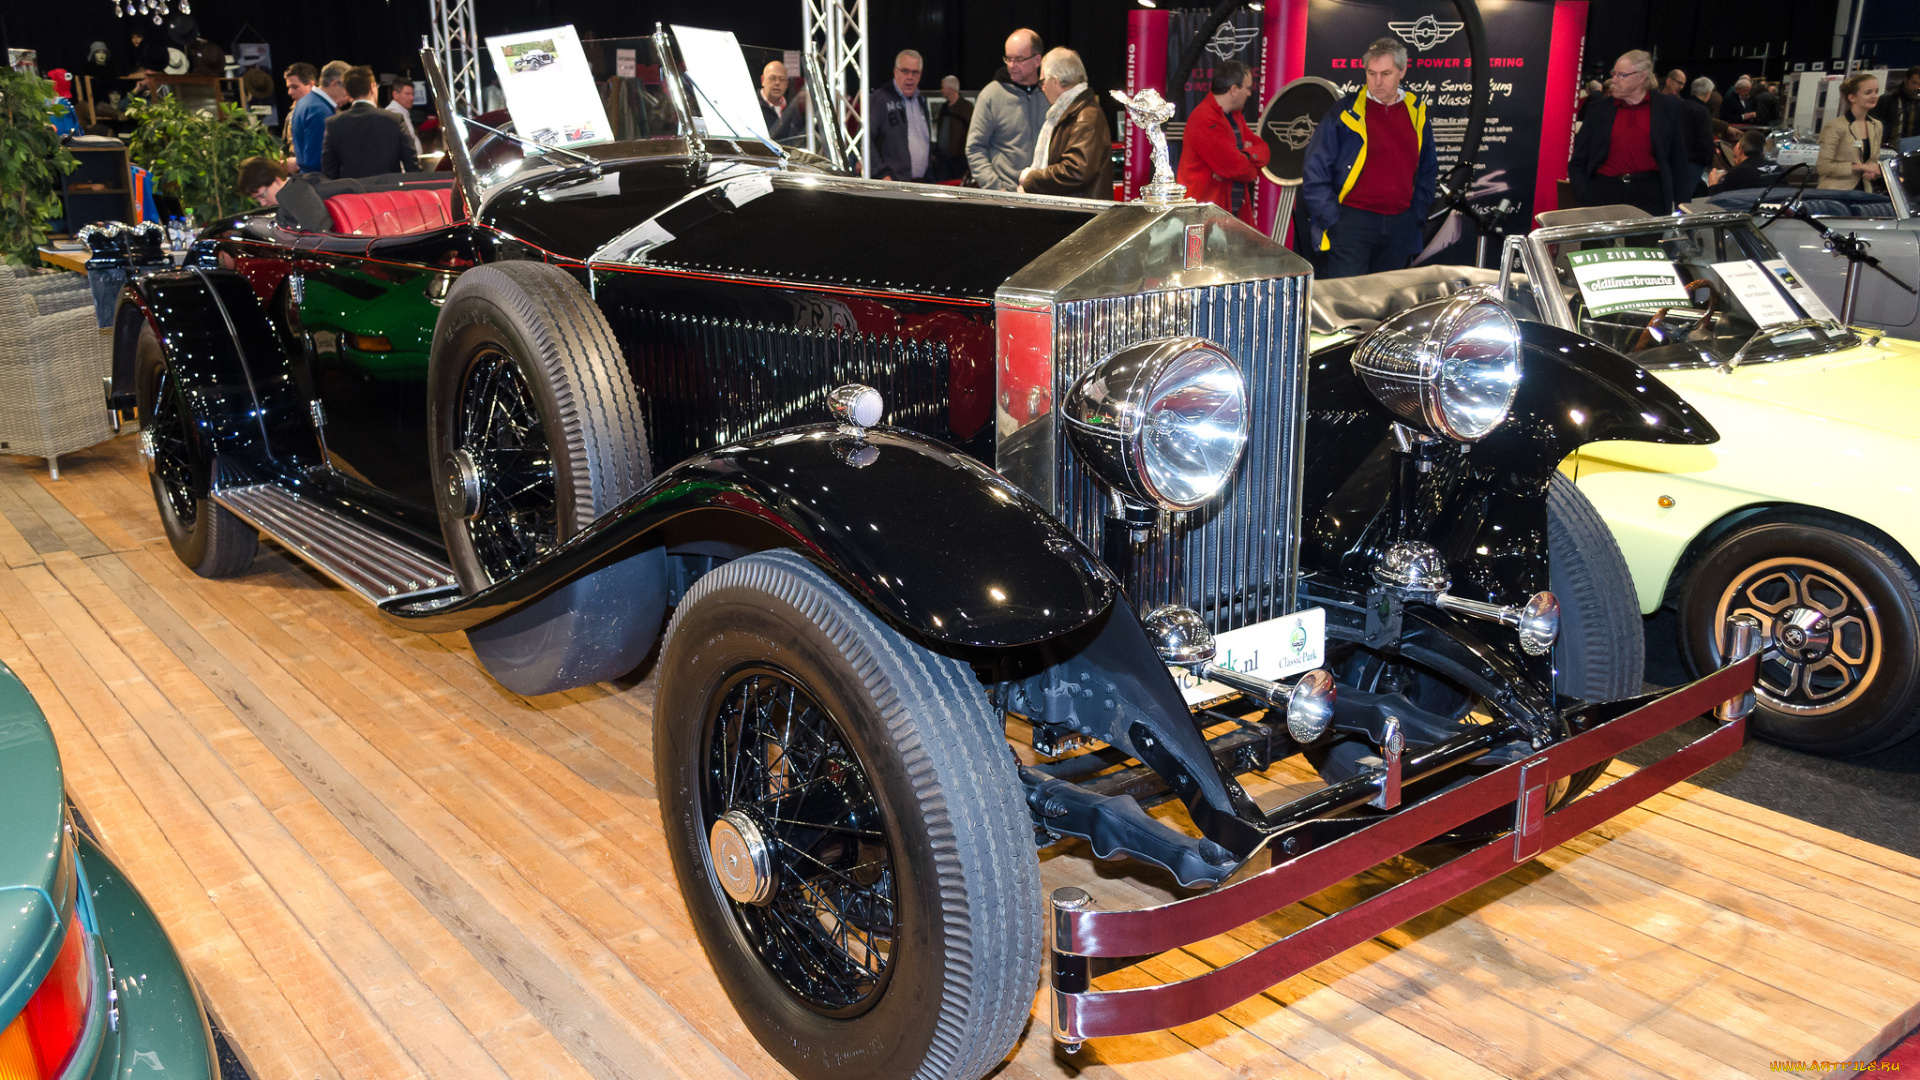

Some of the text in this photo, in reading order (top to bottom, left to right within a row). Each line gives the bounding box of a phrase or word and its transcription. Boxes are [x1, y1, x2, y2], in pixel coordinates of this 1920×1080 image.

[1127, 43, 1136, 97] EERING
[1259, 36, 1268, 113] STEERING
[1332, 58, 1347, 69] EZ
[1416, 58, 1460, 68] POWER
[1463, 57, 1524, 68] SERING
[1573, 36, 1585, 109] STEERING
[1125, 118, 1133, 167] POWER
[1572, 251, 1665, 264] WIJ ZIJN LID
[1591, 275, 1674, 291] oldtimerbranche
